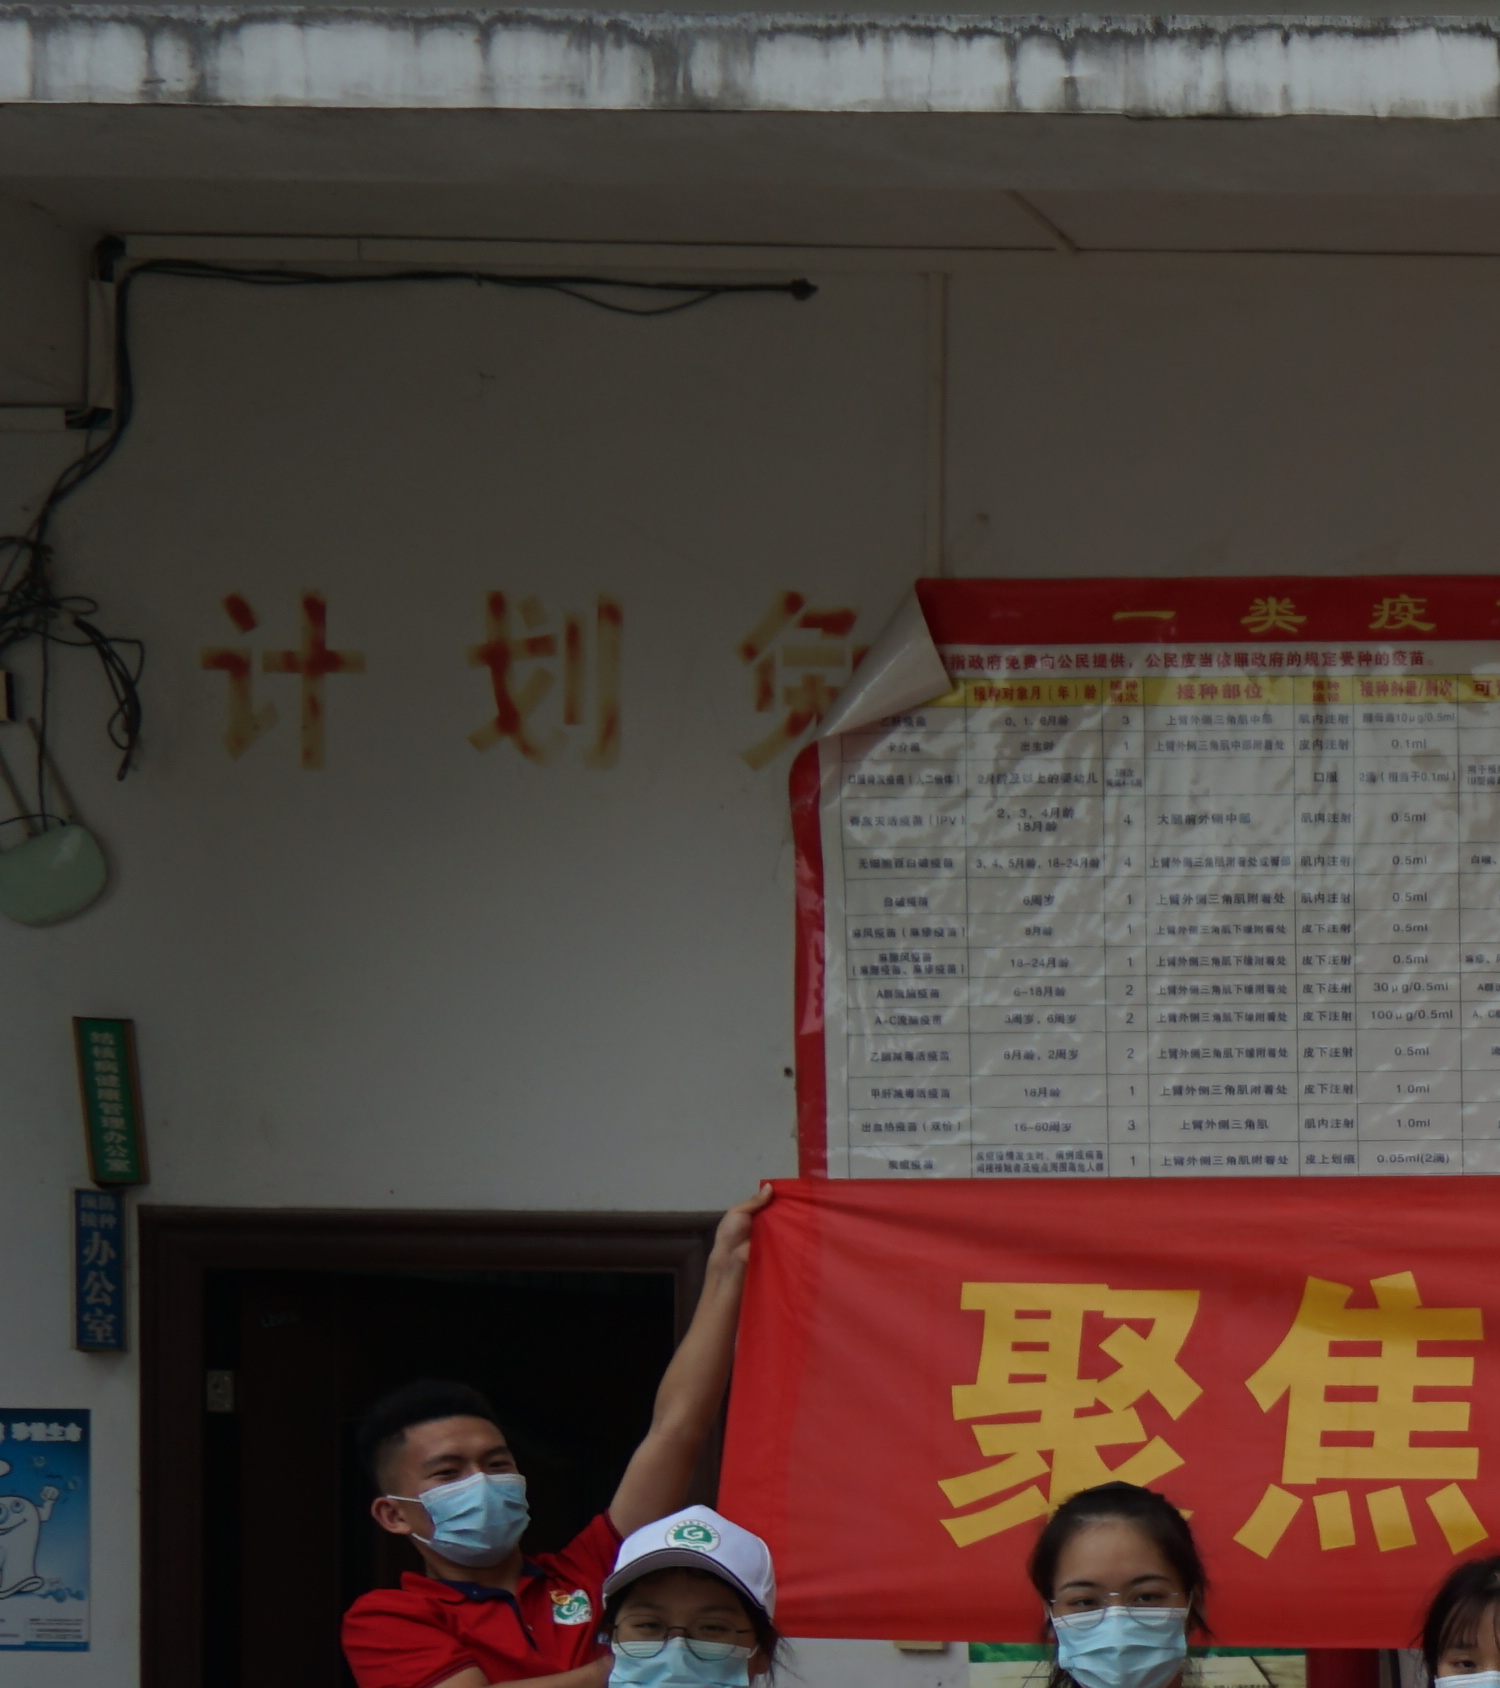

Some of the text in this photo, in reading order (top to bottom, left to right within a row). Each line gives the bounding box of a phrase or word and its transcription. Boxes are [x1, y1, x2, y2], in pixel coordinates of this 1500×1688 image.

[942, 652, 1434, 671] 指政府免费向公民提供，公民应当依照政府的规定受种的疫苗。
[1176, 683, 1263, 700] 接种部位
[1391, 739, 1427, 750] 0.1ml
[1314, 772, 1338, 784] 口服
[1391, 812, 1427, 823] 0.5ml
[1392, 855, 1427, 866] 0.5ml
[1392, 892, 1427, 903] 0.5ml
[1301, 923, 1352, 935] 皮下注射
[1392, 923, 1428, 933] 0.5ml
[1302, 955, 1352, 967] 皮下注射
[1393, 954, 1428, 965] 0.5ml
[1302, 983, 1353, 995] 皮下注射
[1302, 1011, 1353, 1022] 皮下注射
[1303, 1047, 1353, 1058] 皮下注射
[1394, 1046, 1430, 1057] 0.5ml
[1304, 1083, 1354, 1095] 皮下注射
[1396, 1084, 1430, 1094] 1.0ml
[1304, 1118, 1354, 1130] 肌内注射
[1397, 1118, 1431, 1128] 1.0ml
[1305, 1154, 1356, 1165] 皮上划痕
[82, 1231, 117, 1344] 办公室
